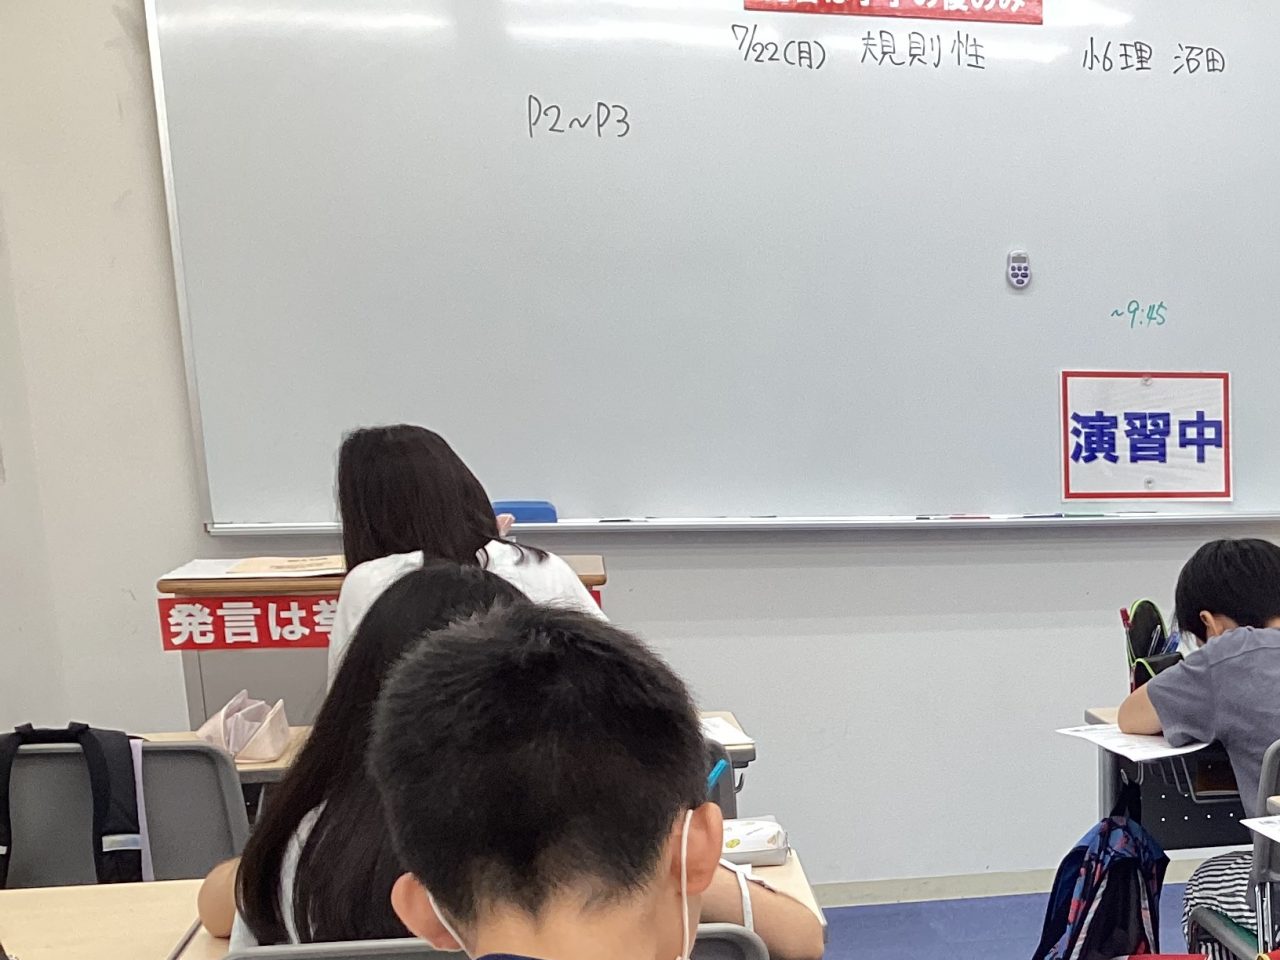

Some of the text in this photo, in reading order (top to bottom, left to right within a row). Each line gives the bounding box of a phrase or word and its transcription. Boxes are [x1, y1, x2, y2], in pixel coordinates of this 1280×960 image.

[861, 29, 986, 69] 規則性
[1070, 410, 1223, 464] 演習中
